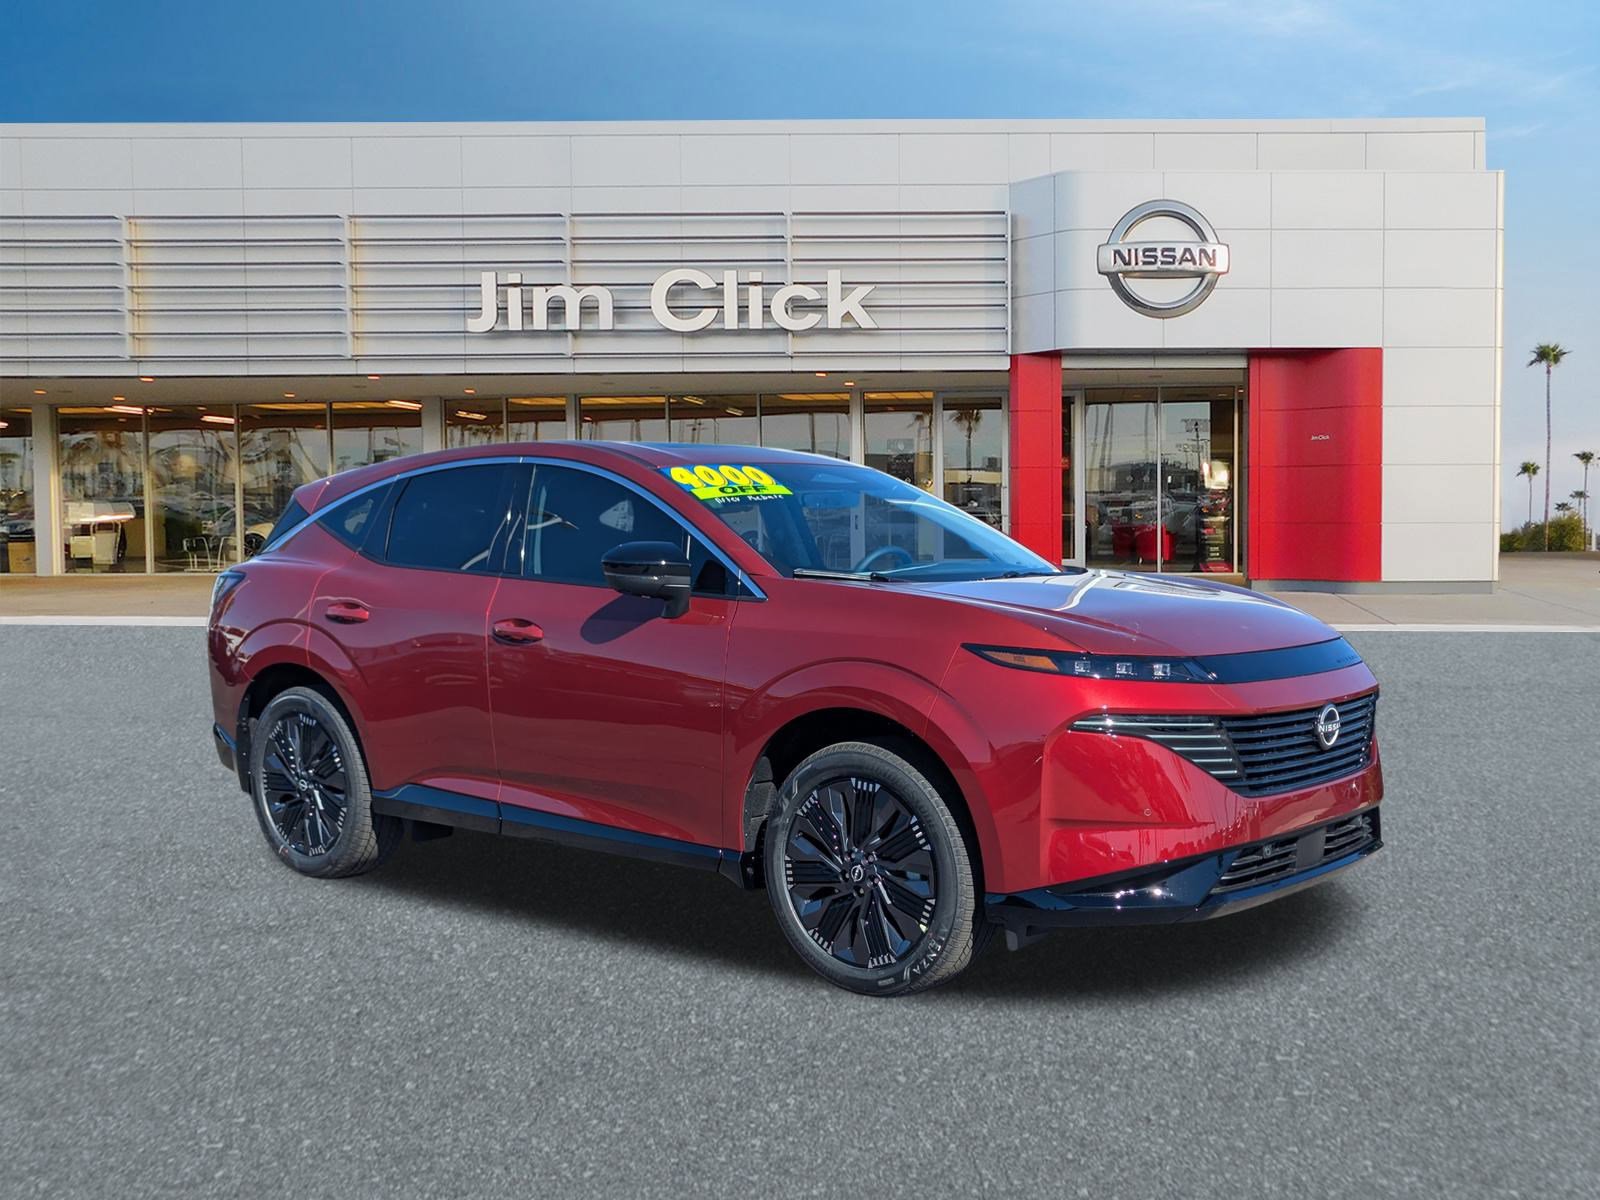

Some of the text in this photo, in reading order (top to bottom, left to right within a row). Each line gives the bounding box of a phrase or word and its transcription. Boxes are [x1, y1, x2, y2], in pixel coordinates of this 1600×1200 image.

[1112, 247, 1217, 266] NISSAN
[466, 268, 879, 333] Jim Click
[670, 465, 776, 489] 4000
[718, 486, 768, 494] OFF
